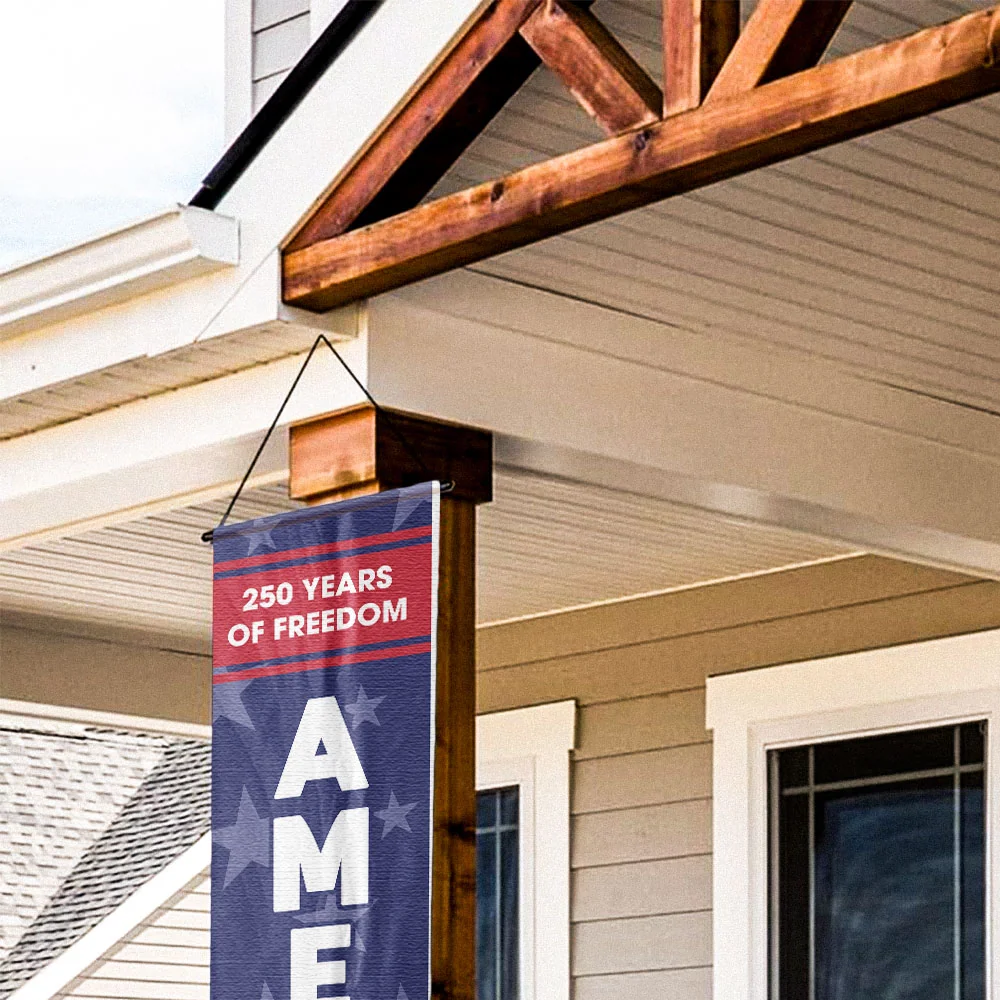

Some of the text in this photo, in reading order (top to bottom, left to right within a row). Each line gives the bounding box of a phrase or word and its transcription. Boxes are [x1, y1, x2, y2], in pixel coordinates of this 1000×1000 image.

[242, 565, 393, 612] 250 YEARS
[227, 597, 408, 647] OF FREEDOM
